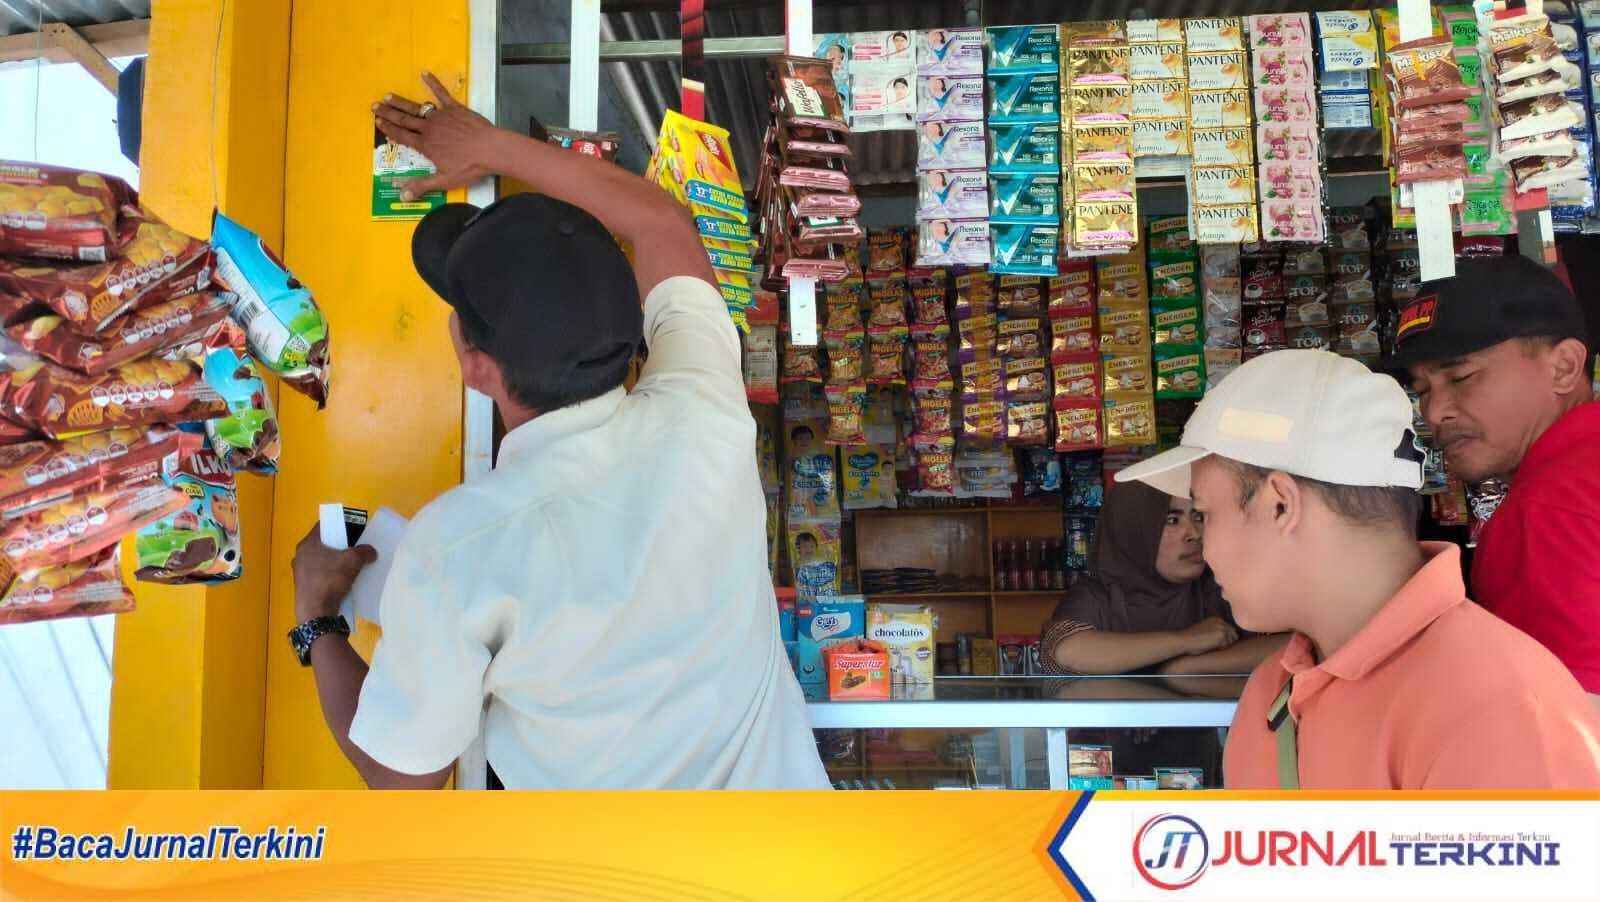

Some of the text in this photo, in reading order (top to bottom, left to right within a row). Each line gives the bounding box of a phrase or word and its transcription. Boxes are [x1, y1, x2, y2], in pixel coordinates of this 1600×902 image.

[1186, 20, 1239, 29] PANTENE
[1073, 49, 1126, 60] PANTENE
[1129, 45, 1183, 56] PANTENE
[1189, 55, 1241, 66] PANTENE
[1029, 85, 1054, 93] Rexona
[1074, 87, 1128, 99] PANTENE
[1131, 83, 1184, 93] PANTENE
[1191, 94, 1244, 104] PANTENE
[954, 125, 979, 133] Rexona
[1133, 120, 1185, 131] PANTENE
[1075, 126, 1130, 138] PANTENE
[1193, 131, 1246, 142] PANTENE
[1030, 136, 1055, 144] Rexona
[1077, 165, 1131, 178] PANTENE
[1195, 169, 1249, 181] PANTENE
[1030, 186, 1055, 194] Rexona
[1079, 204, 1133, 216] PANTENE
[1198, 208, 1251, 219] PANTENE
[959, 225, 985, 233] Rexona
[1030, 237, 1054, 245] Rexona
[1101, 266, 1138, 277] ENERGEN
[1155, 265, 1192, 276] ENERGEN
[1339, 264, 1364, 273] TOP
[1051, 275, 1087, 286] ENERGEN
[1295, 288, 1318, 296] TOP
[1103, 312, 1139, 323] ENERGEN
[1158, 311, 1195, 323] ENERGEN
[1344, 315, 1368, 324] TOP
[1054, 320, 1091, 331] ENERGEN
[1295, 338, 1322, 347] TOP
[1107, 358, 1144, 369] ENERGEN
[1161, 357, 1197, 369] ENERGEN
[1057, 366, 1093, 377] ENERGEN
